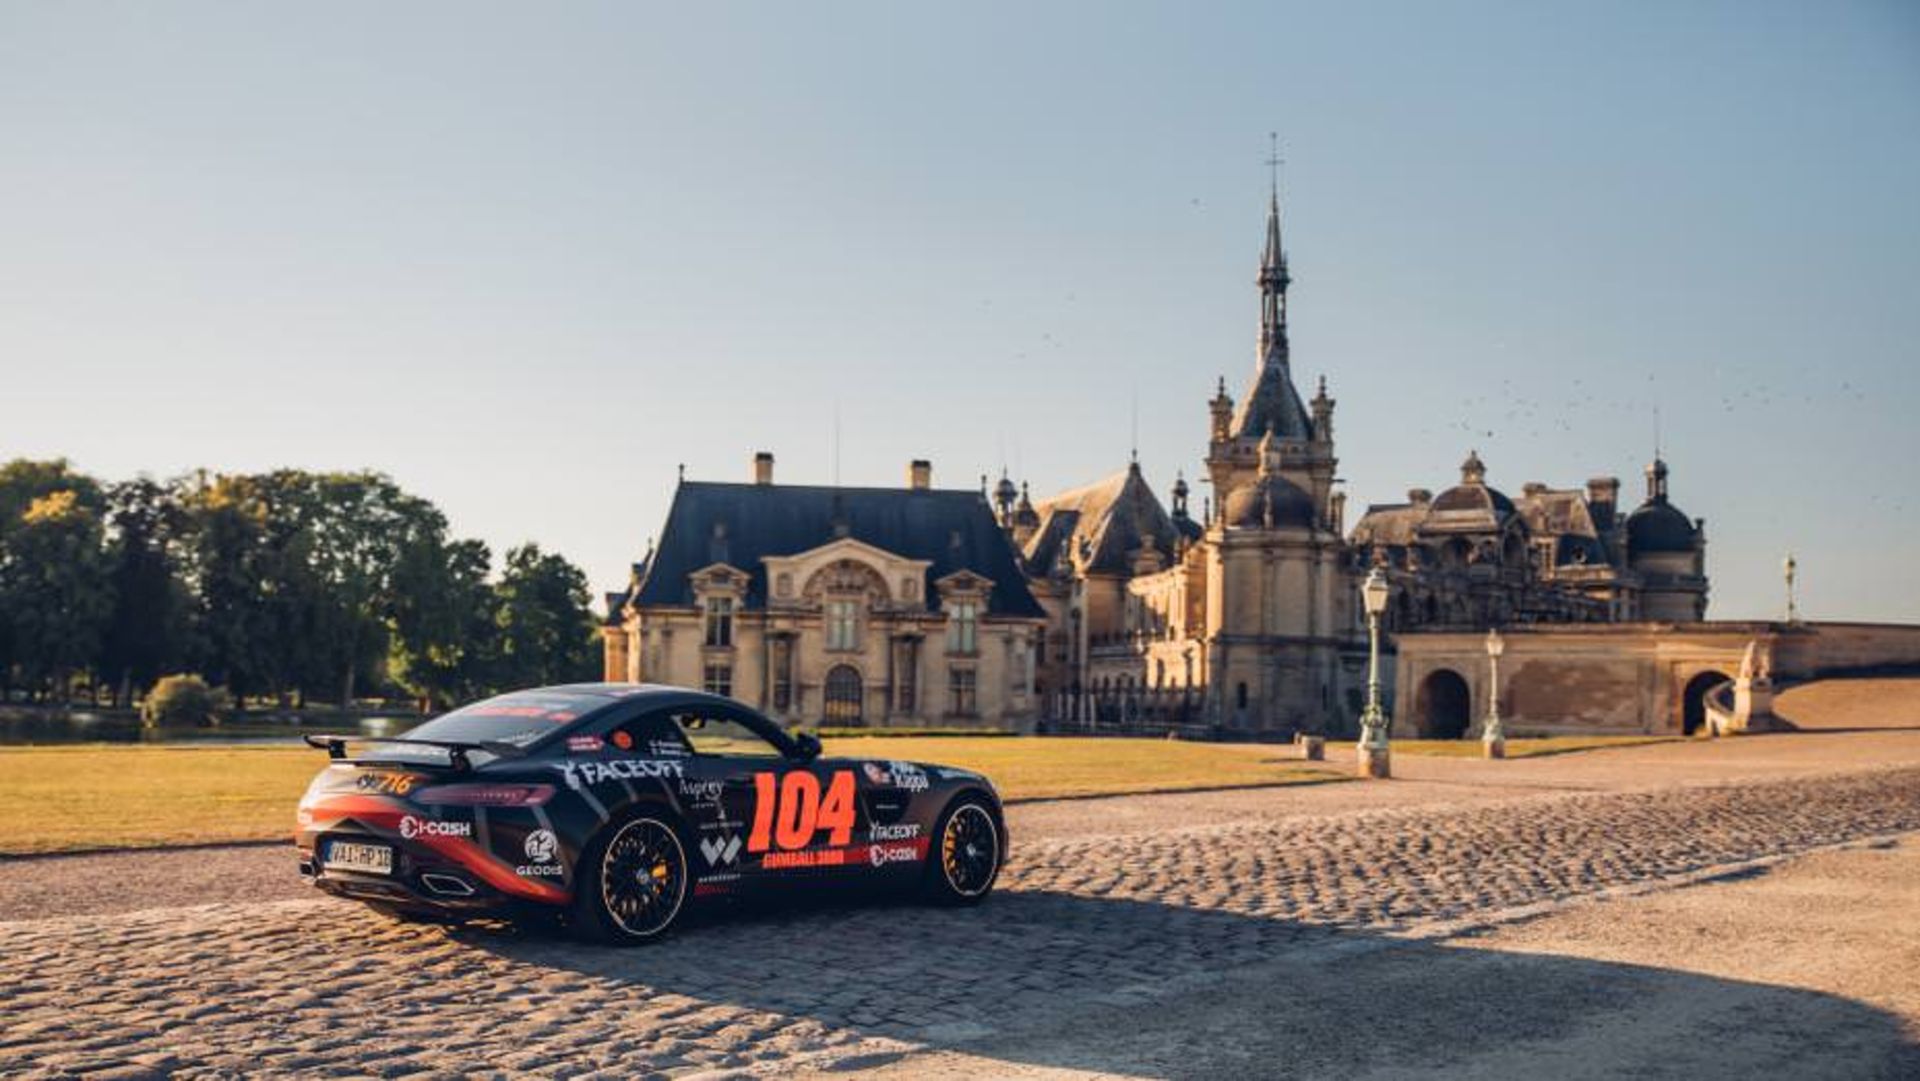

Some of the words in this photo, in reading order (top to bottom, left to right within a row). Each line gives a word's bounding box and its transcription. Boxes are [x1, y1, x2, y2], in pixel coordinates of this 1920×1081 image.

[579, 760, 683, 784] FACEOFF
[747, 770, 856, 852] 104
[516, 865, 563, 876] GEODIS
